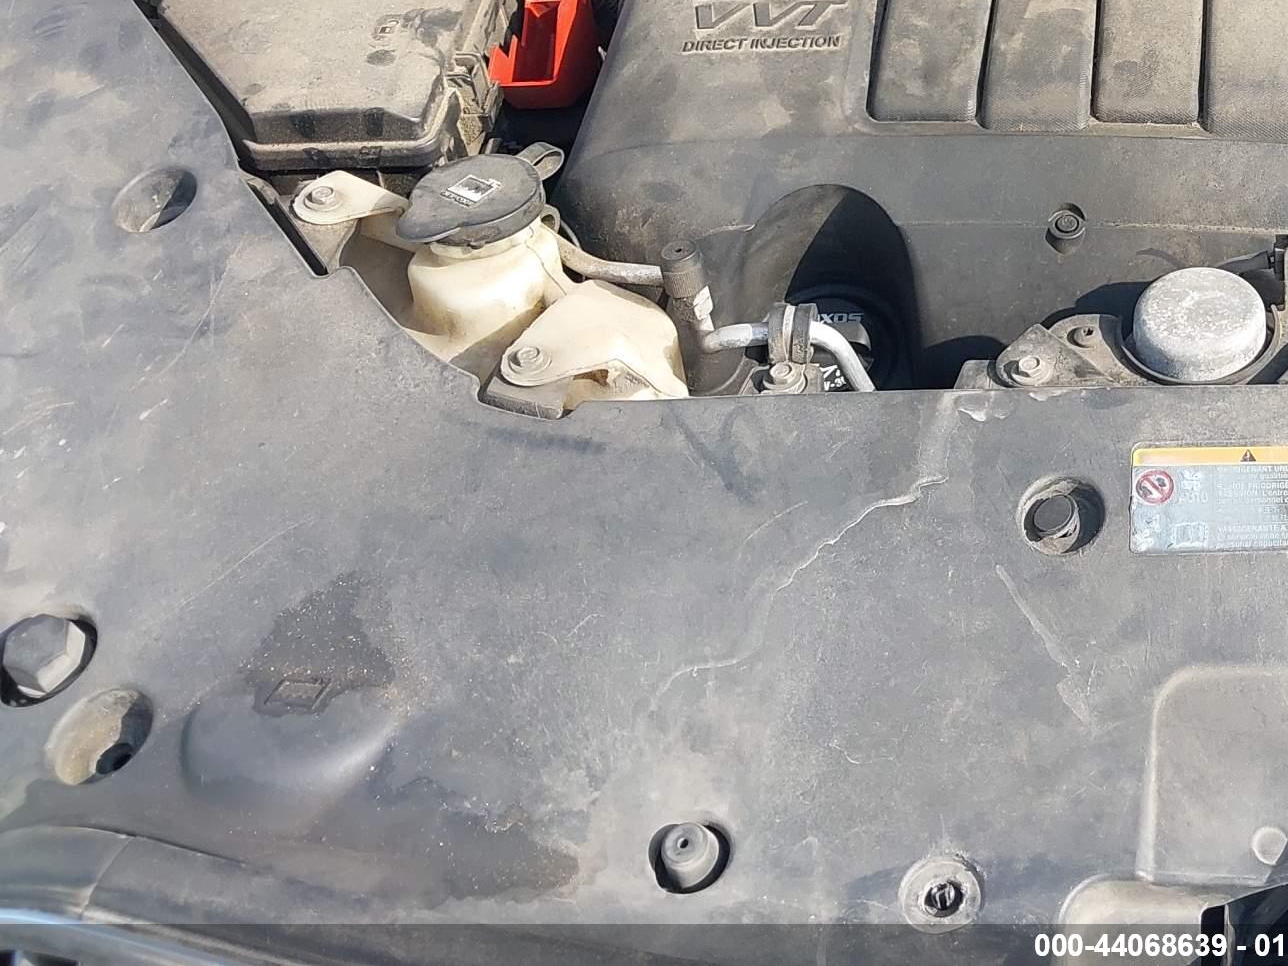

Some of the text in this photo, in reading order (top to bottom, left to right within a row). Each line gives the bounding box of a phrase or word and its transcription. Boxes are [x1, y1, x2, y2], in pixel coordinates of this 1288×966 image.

[694, 0, 849, 30] VVT
[682, 35, 841, 53] DIRECT INJECTION
